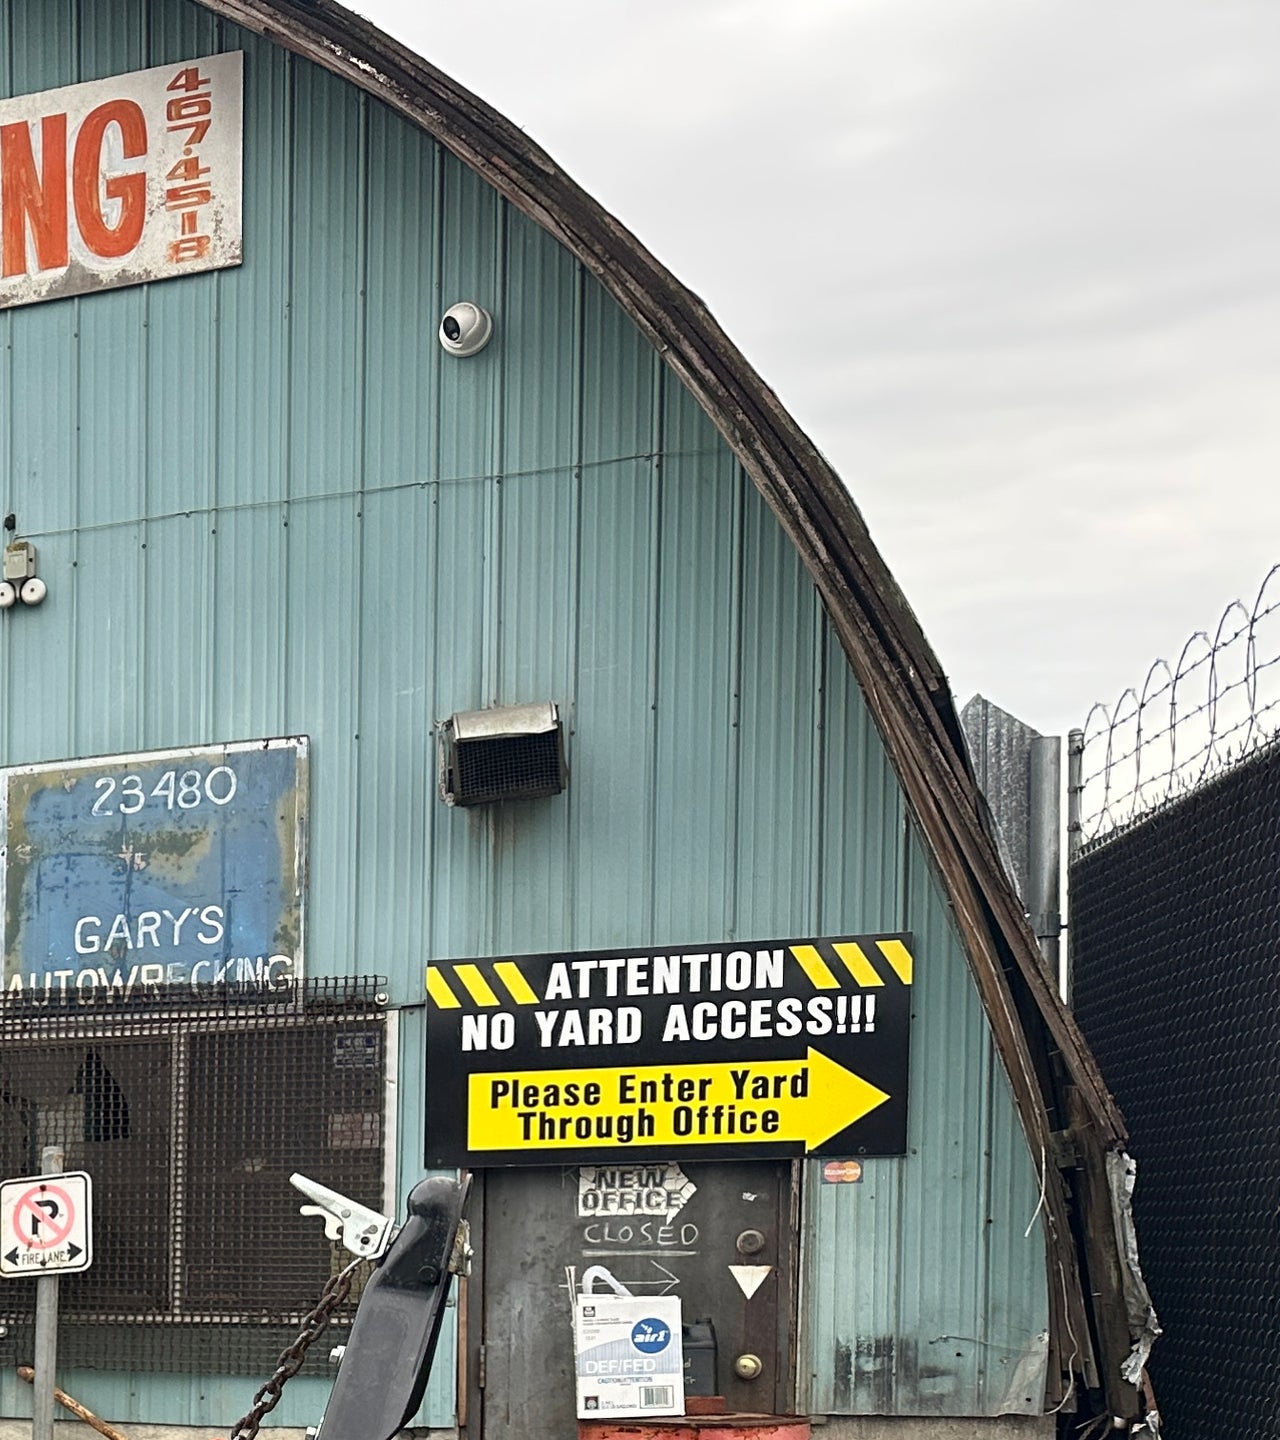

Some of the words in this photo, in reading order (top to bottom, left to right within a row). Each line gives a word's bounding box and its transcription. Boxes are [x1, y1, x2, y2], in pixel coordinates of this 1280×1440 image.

[91, 766, 238, 817] 23480
[74, 905, 225, 954] GARY'S
[544, 949, 785, 1001] ATTENTION
[461, 1012, 516, 1052] NO
[536, 1001, 642, 1048] YARD
[662, 995, 877, 1043] ACCESS!!!
[491, 1079, 601, 1109] Please
[619, 1074, 713, 1103] Enter
[730, 1068, 809, 1100] Yard
[517, 1108, 655, 1143] Through
[673, 1106, 780, 1136] Office
[597, 1169, 665, 1189] NEW
[581, 1188, 682, 1210] OFFICE
[584, 1222, 699, 1245] CLOSED
[21, 1252, 40, 1265] FIRE
[585, 1358, 657, 1374] DEF/FED
